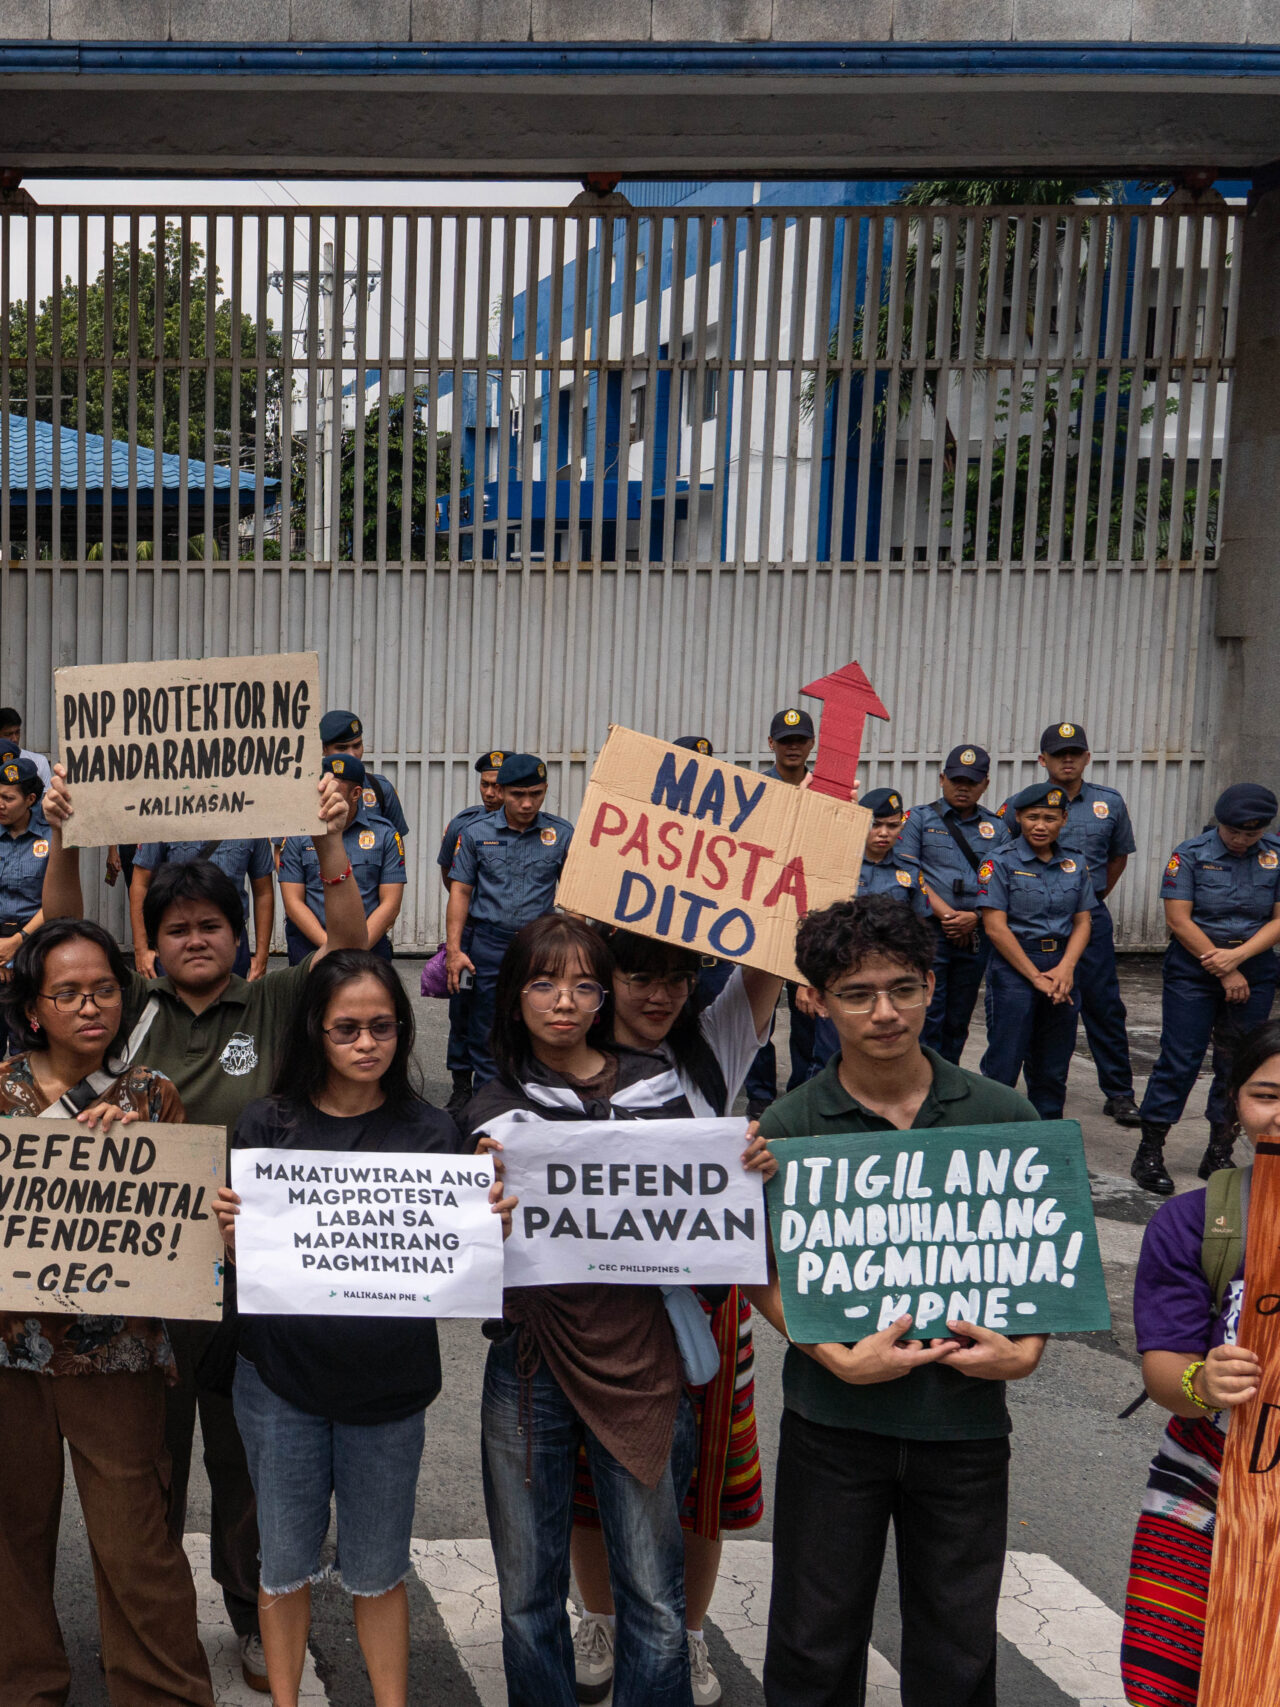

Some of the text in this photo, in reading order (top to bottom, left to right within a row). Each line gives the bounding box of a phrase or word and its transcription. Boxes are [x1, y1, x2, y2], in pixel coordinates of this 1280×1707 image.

[63, 680, 311, 741] PNP PROTEKTOR NG
[66, 734, 305, 784] MANDARAMBONG!
[651, 752, 766, 832] MAY
[589, 802, 808, 919] PASISTA
[614, 869, 756, 957] DITO
[255, 1162, 491, 1188] MAKATUWIRAN ANG
[547, 1163, 729, 1197] DEFEND
[783, 1146, 1049, 1206] ITIGIL ANG
[288, 1187, 459, 1208] MAGPROTESTA
[316, 1209, 434, 1227] LABAN SA
[523, 1206, 755, 1241] PALAWAN
[780, 1197, 1067, 1253] DAMBUHALANG
[293, 1231, 460, 1251] MAPANIRANG
[302, 1254, 454, 1274] PAGMIMINA!
[598, 1264, 680, 1274] CEC PHILIPPINES
[797, 1230, 1083, 1295] PAGMIMINA!
[343, 1290, 417, 1301] KALIKASAN PNE
